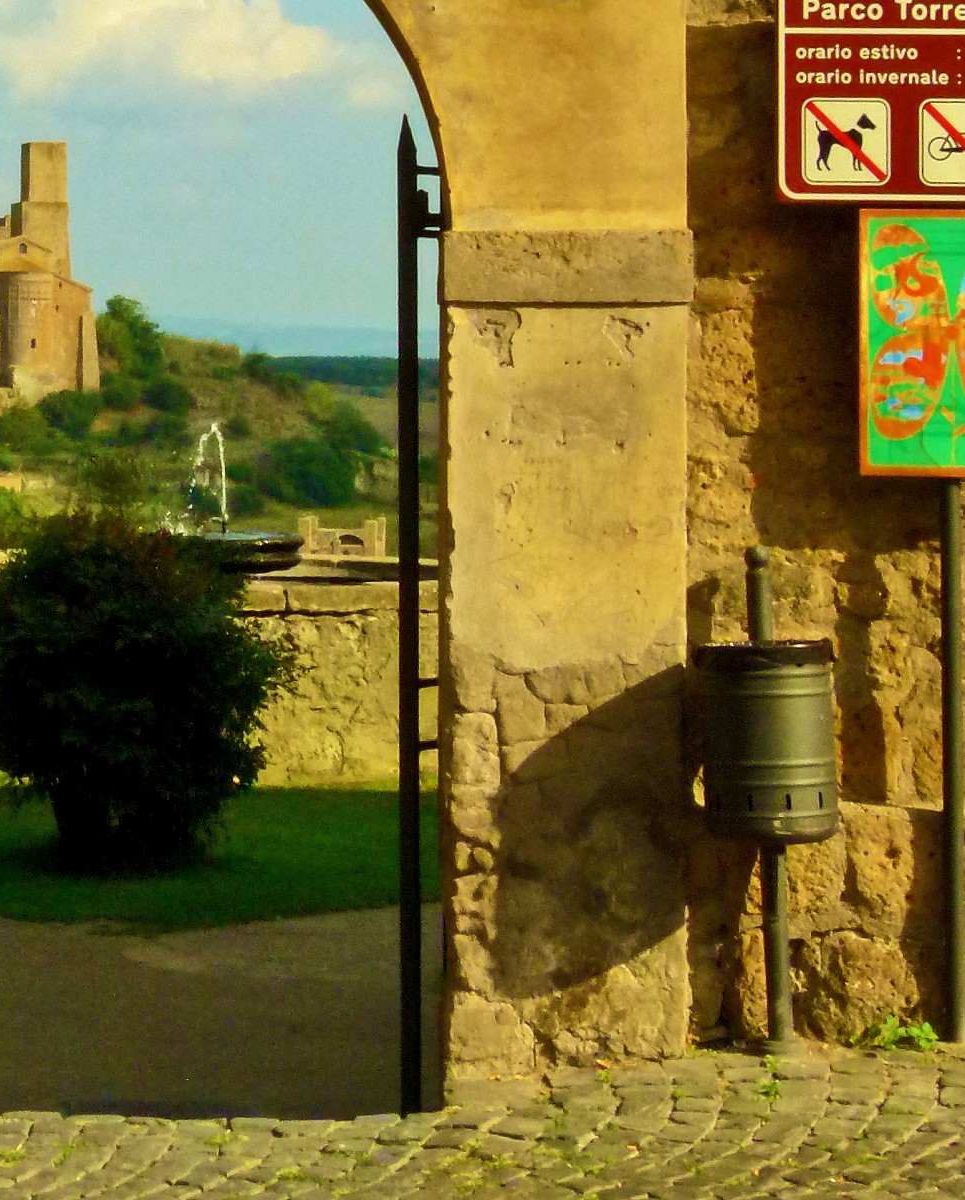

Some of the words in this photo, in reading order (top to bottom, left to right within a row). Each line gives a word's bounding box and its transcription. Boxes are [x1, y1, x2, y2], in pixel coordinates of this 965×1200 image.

[795, 44, 852, 60] orario
[859, 44, 918, 60] estivo
[795, 69, 852, 85] orario
[859, 69, 949, 85] invernale
